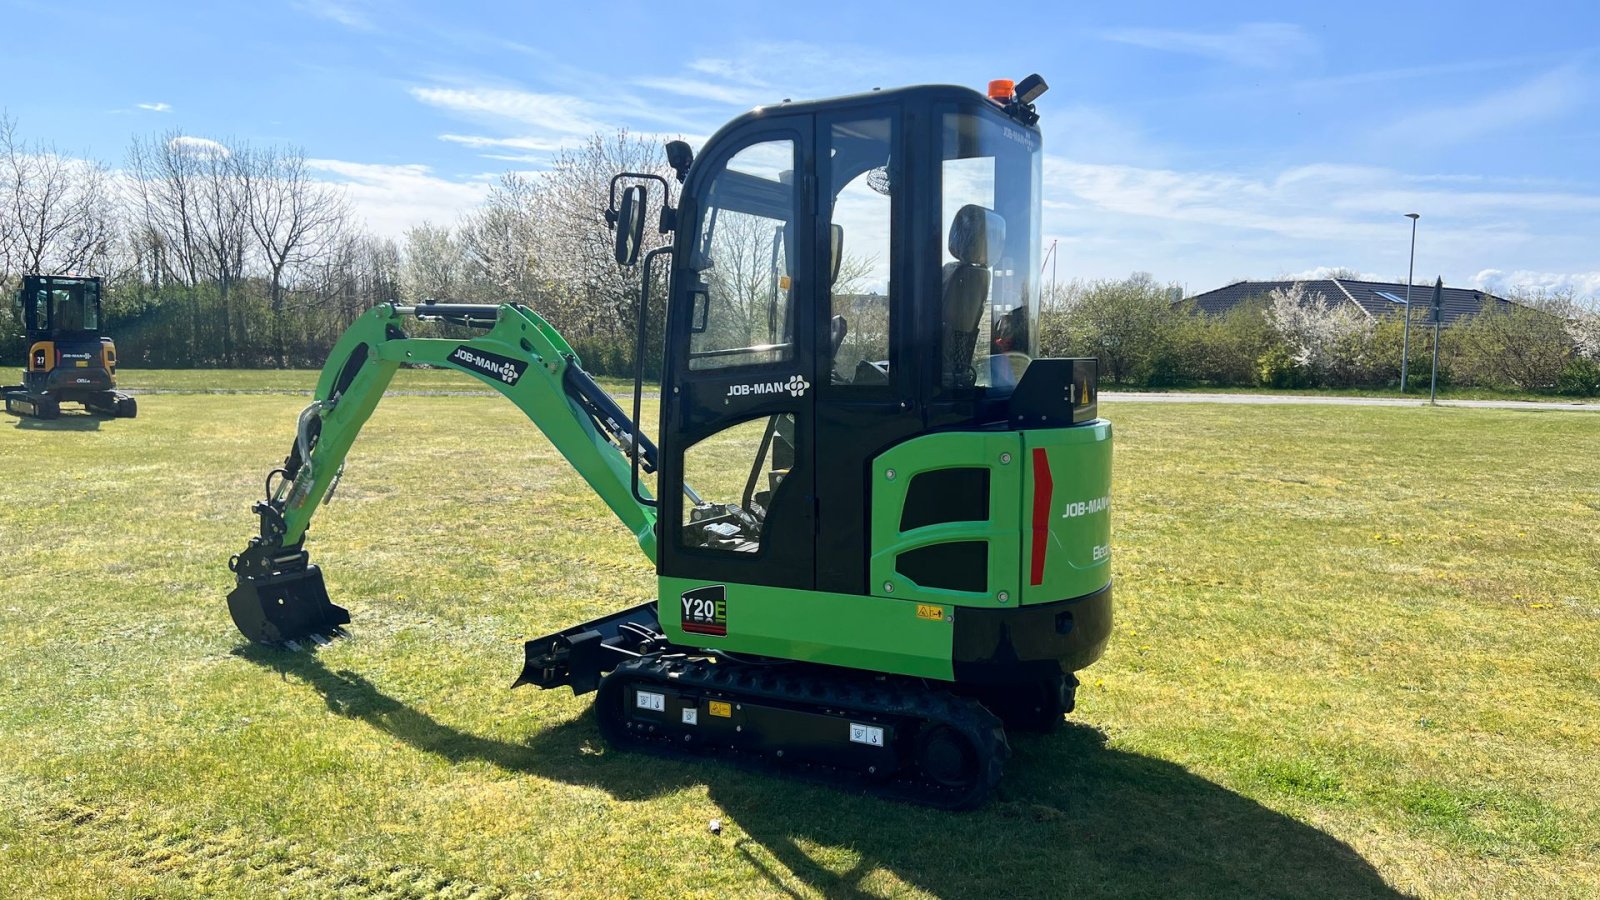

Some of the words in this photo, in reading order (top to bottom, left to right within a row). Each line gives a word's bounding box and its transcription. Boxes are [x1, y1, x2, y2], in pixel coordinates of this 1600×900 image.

[36, 356, 45, 365] 27
[454, 348, 499, 373] JOB-MAN
[727, 382, 784, 396] JOB-MAN
[1062, 496, 1107, 518] JOB-MAN
[682, 597, 726, 619] Y20E
